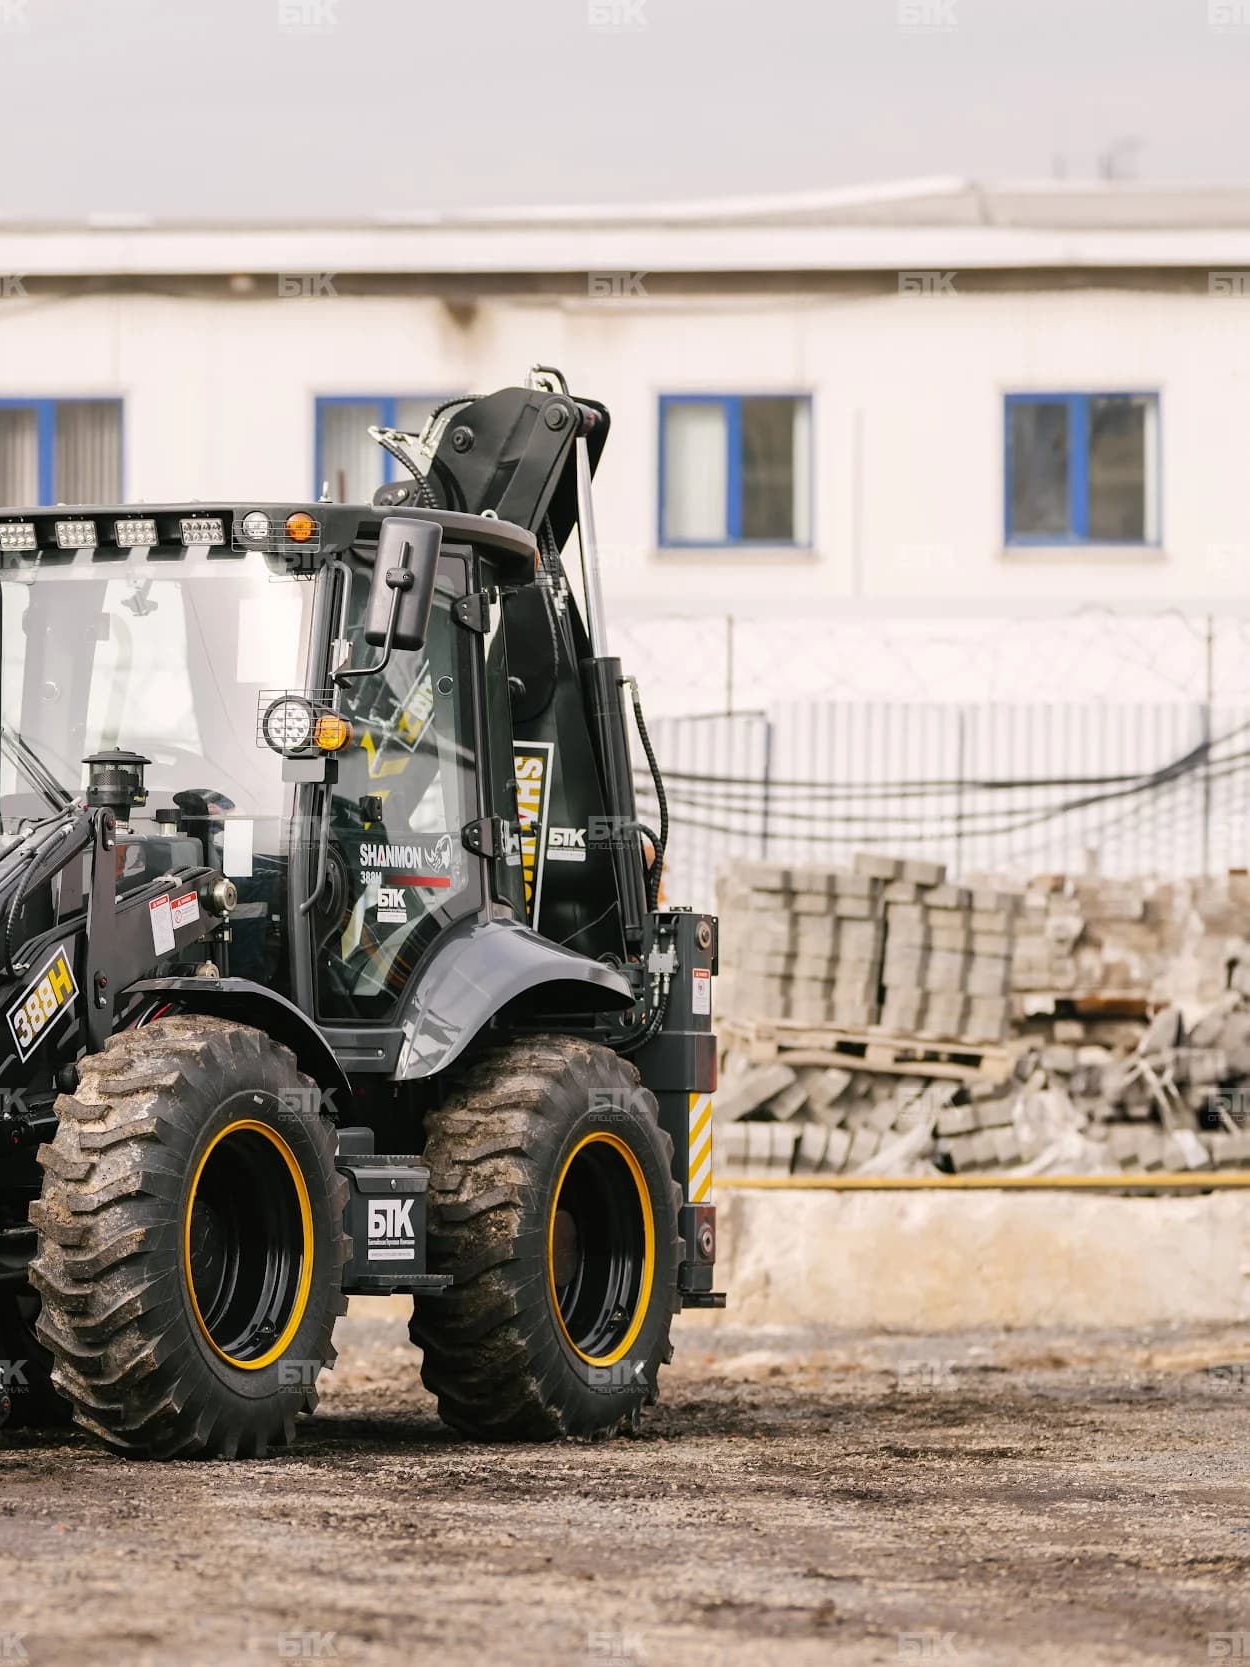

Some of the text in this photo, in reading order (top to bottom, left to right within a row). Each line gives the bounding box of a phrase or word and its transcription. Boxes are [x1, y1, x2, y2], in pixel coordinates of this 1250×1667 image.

[548, 827, 586, 847] БТК
[360, 844, 422, 868] SHANMON
[378, 889, 406, 908] БТК
[14, 957, 73, 1047] 388H
[368, 1199, 415, 1237] БТК
